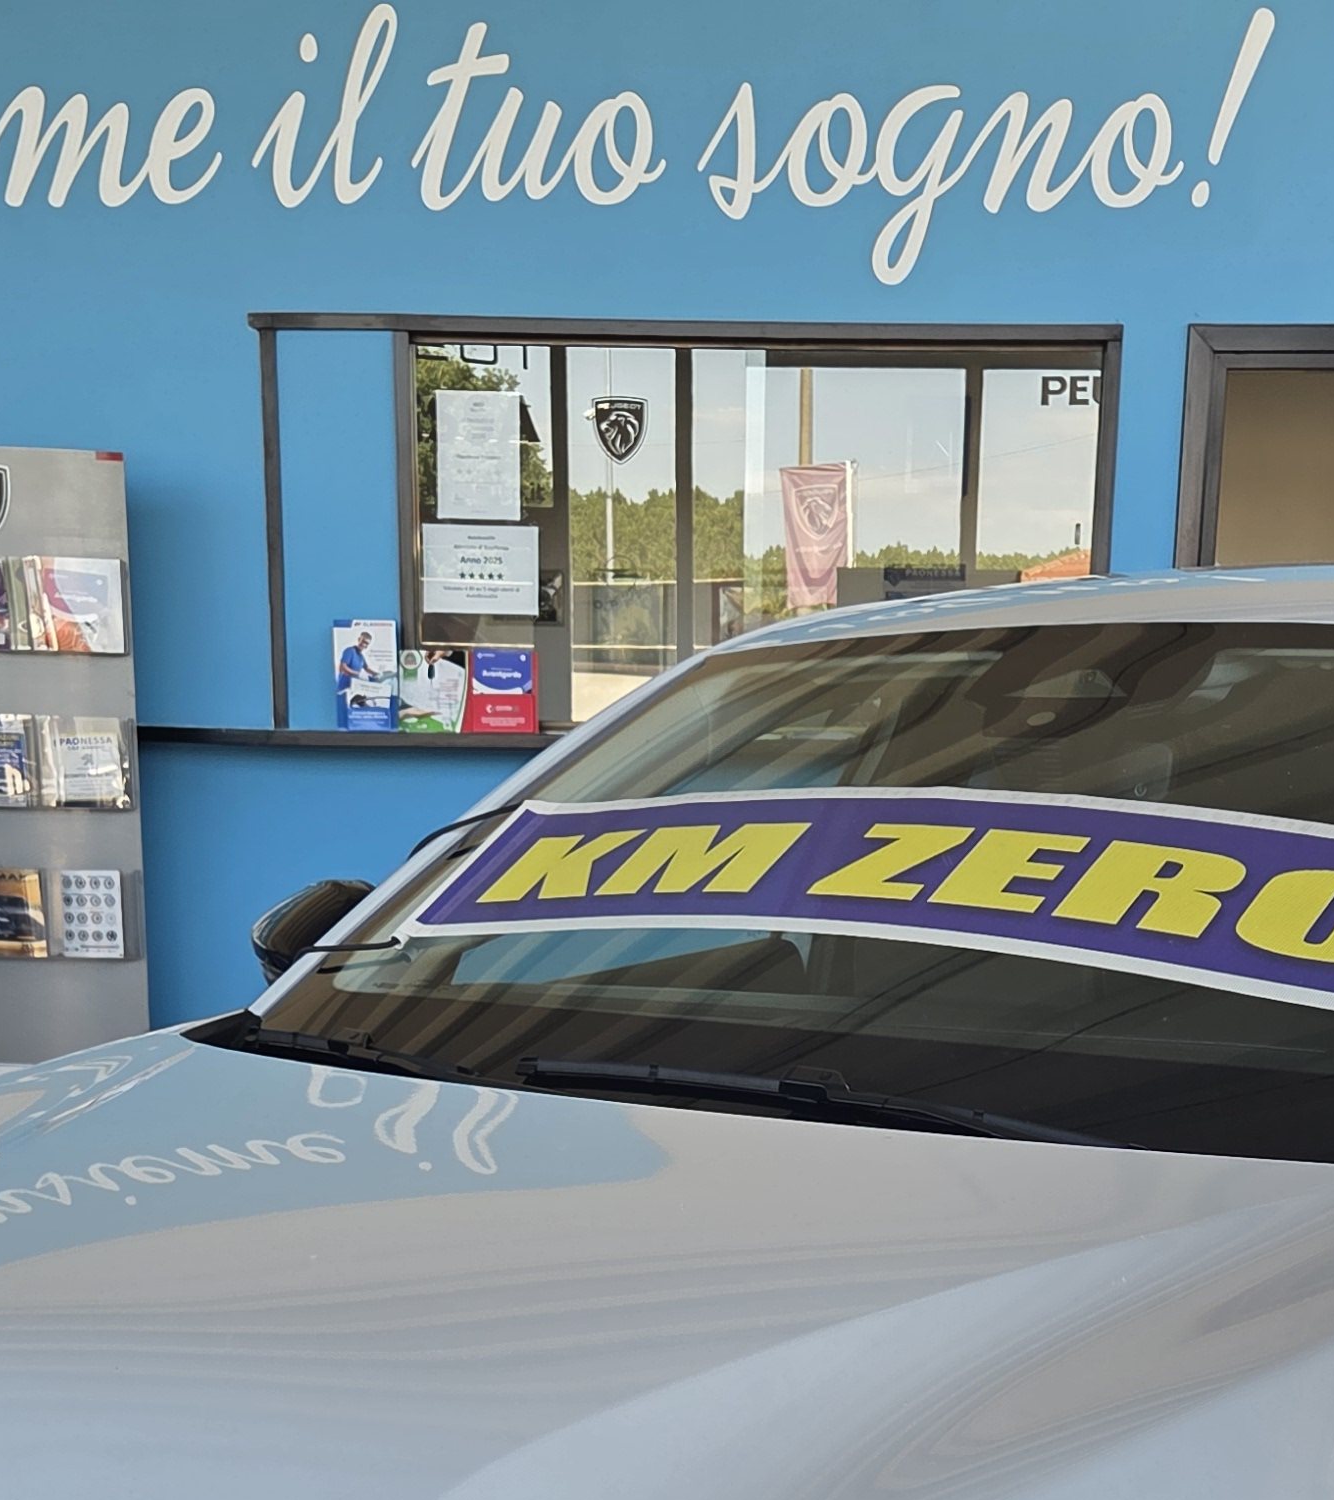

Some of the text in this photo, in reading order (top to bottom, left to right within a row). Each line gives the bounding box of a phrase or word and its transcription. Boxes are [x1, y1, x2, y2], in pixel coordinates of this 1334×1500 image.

[251, 2, 398, 209] il
[411, 21, 667, 212] tuo
[697, 6, 1276, 286] sogno!
[460, 555, 482, 565] Anno
[478, 822, 813, 904] KM
